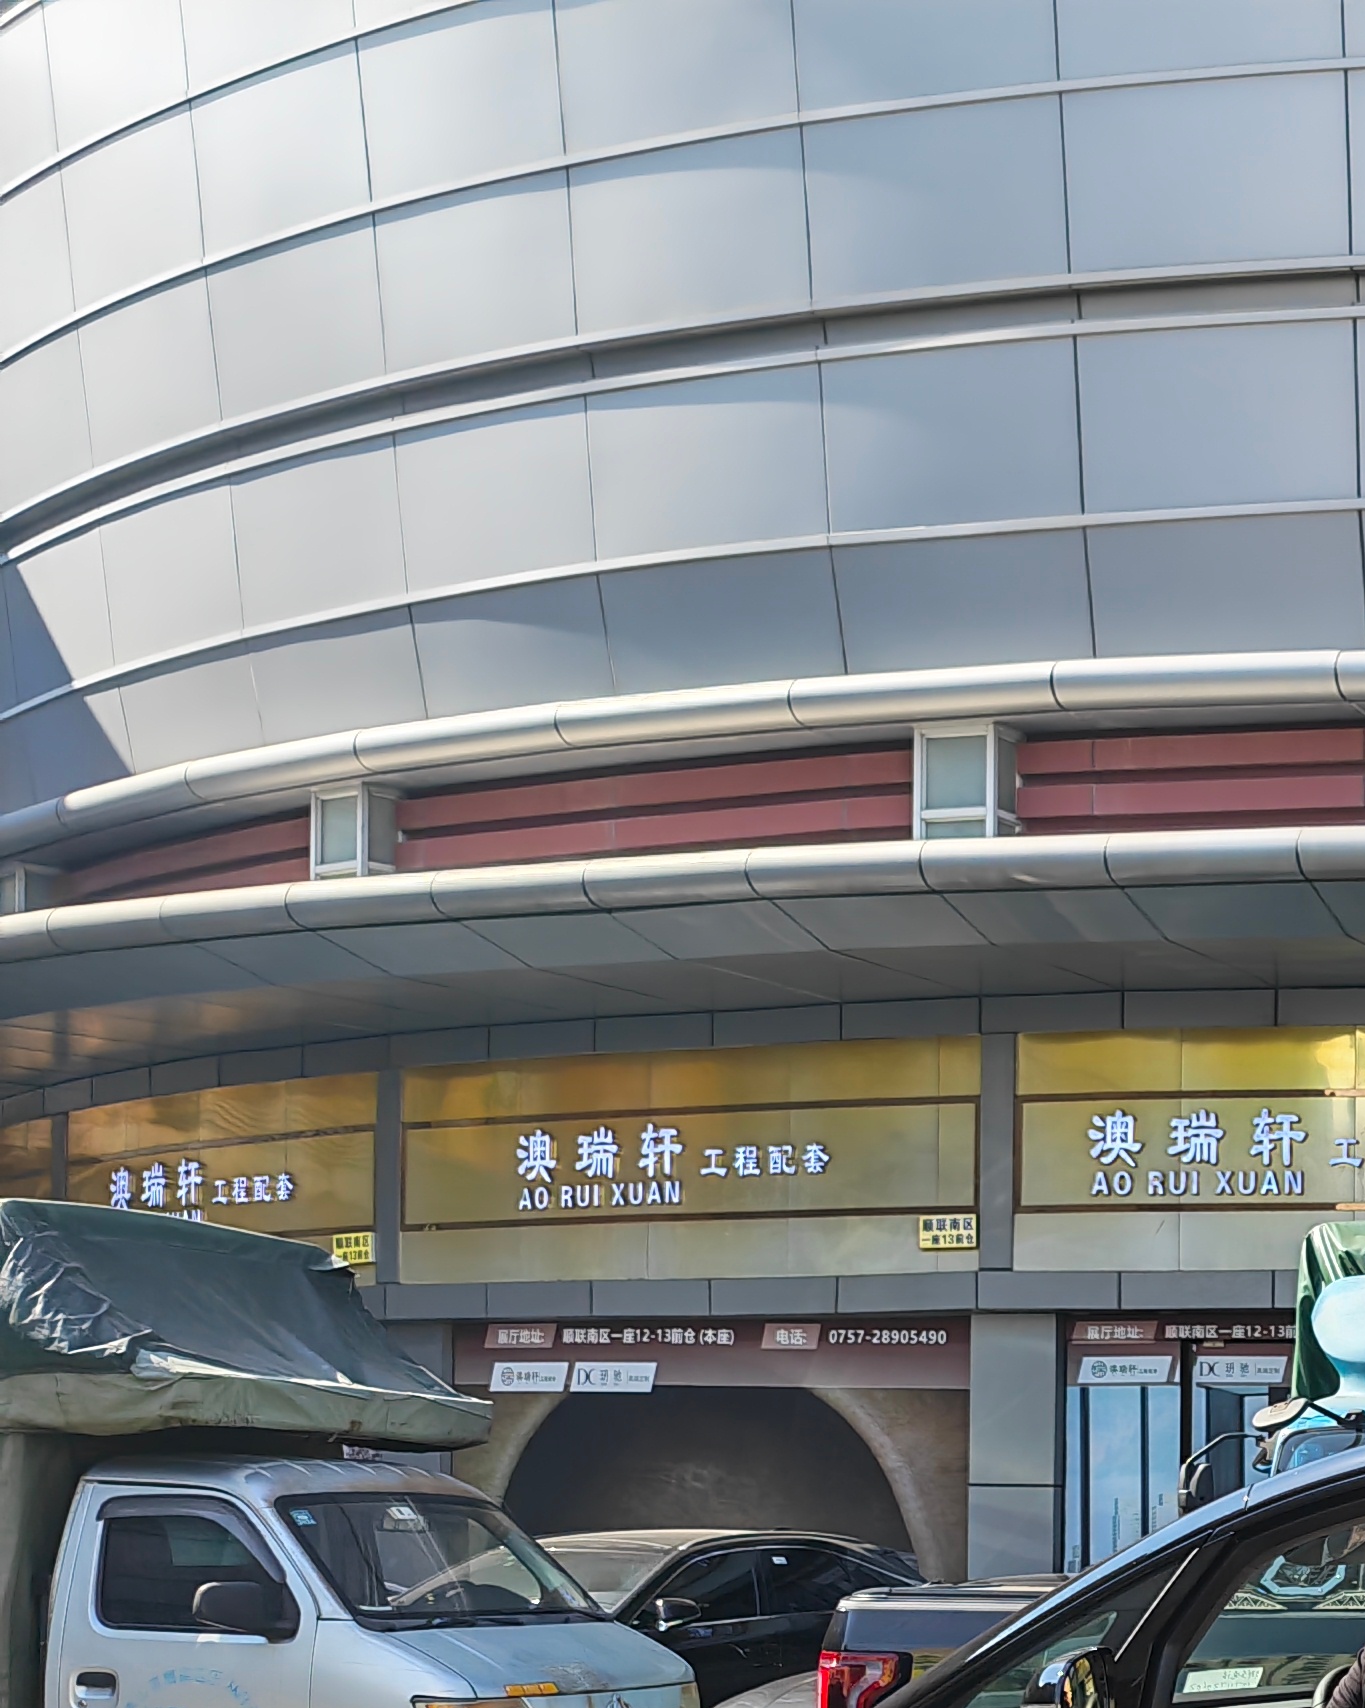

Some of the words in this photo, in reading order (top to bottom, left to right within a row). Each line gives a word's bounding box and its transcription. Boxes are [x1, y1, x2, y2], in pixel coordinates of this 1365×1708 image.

[1087, 1108, 1307, 1167] 澳瑞轩
[516, 1123, 683, 1183] 澳瑞轩
[700, 1143, 830, 1177] 工程配套
[110, 1158, 203, 1209] 澳瑞轩
[212, 1173, 293, 1204] 工程配套
[518, 1187, 550, 1211] AO
[561, 1184, 600, 1208] RUI
[611, 1181, 681, 1205] XUAN
[1091, 1171, 1133, 1196] AO
[1147, 1170, 1199, 1196] RUI
[1215, 1170, 1305, 1195] XUAN
[922, 1217, 974, 1232] 顺联南区
[922, 1233, 975, 1246] 一座13前仓
[828, 1329, 948, 1346] 0757-28905490
